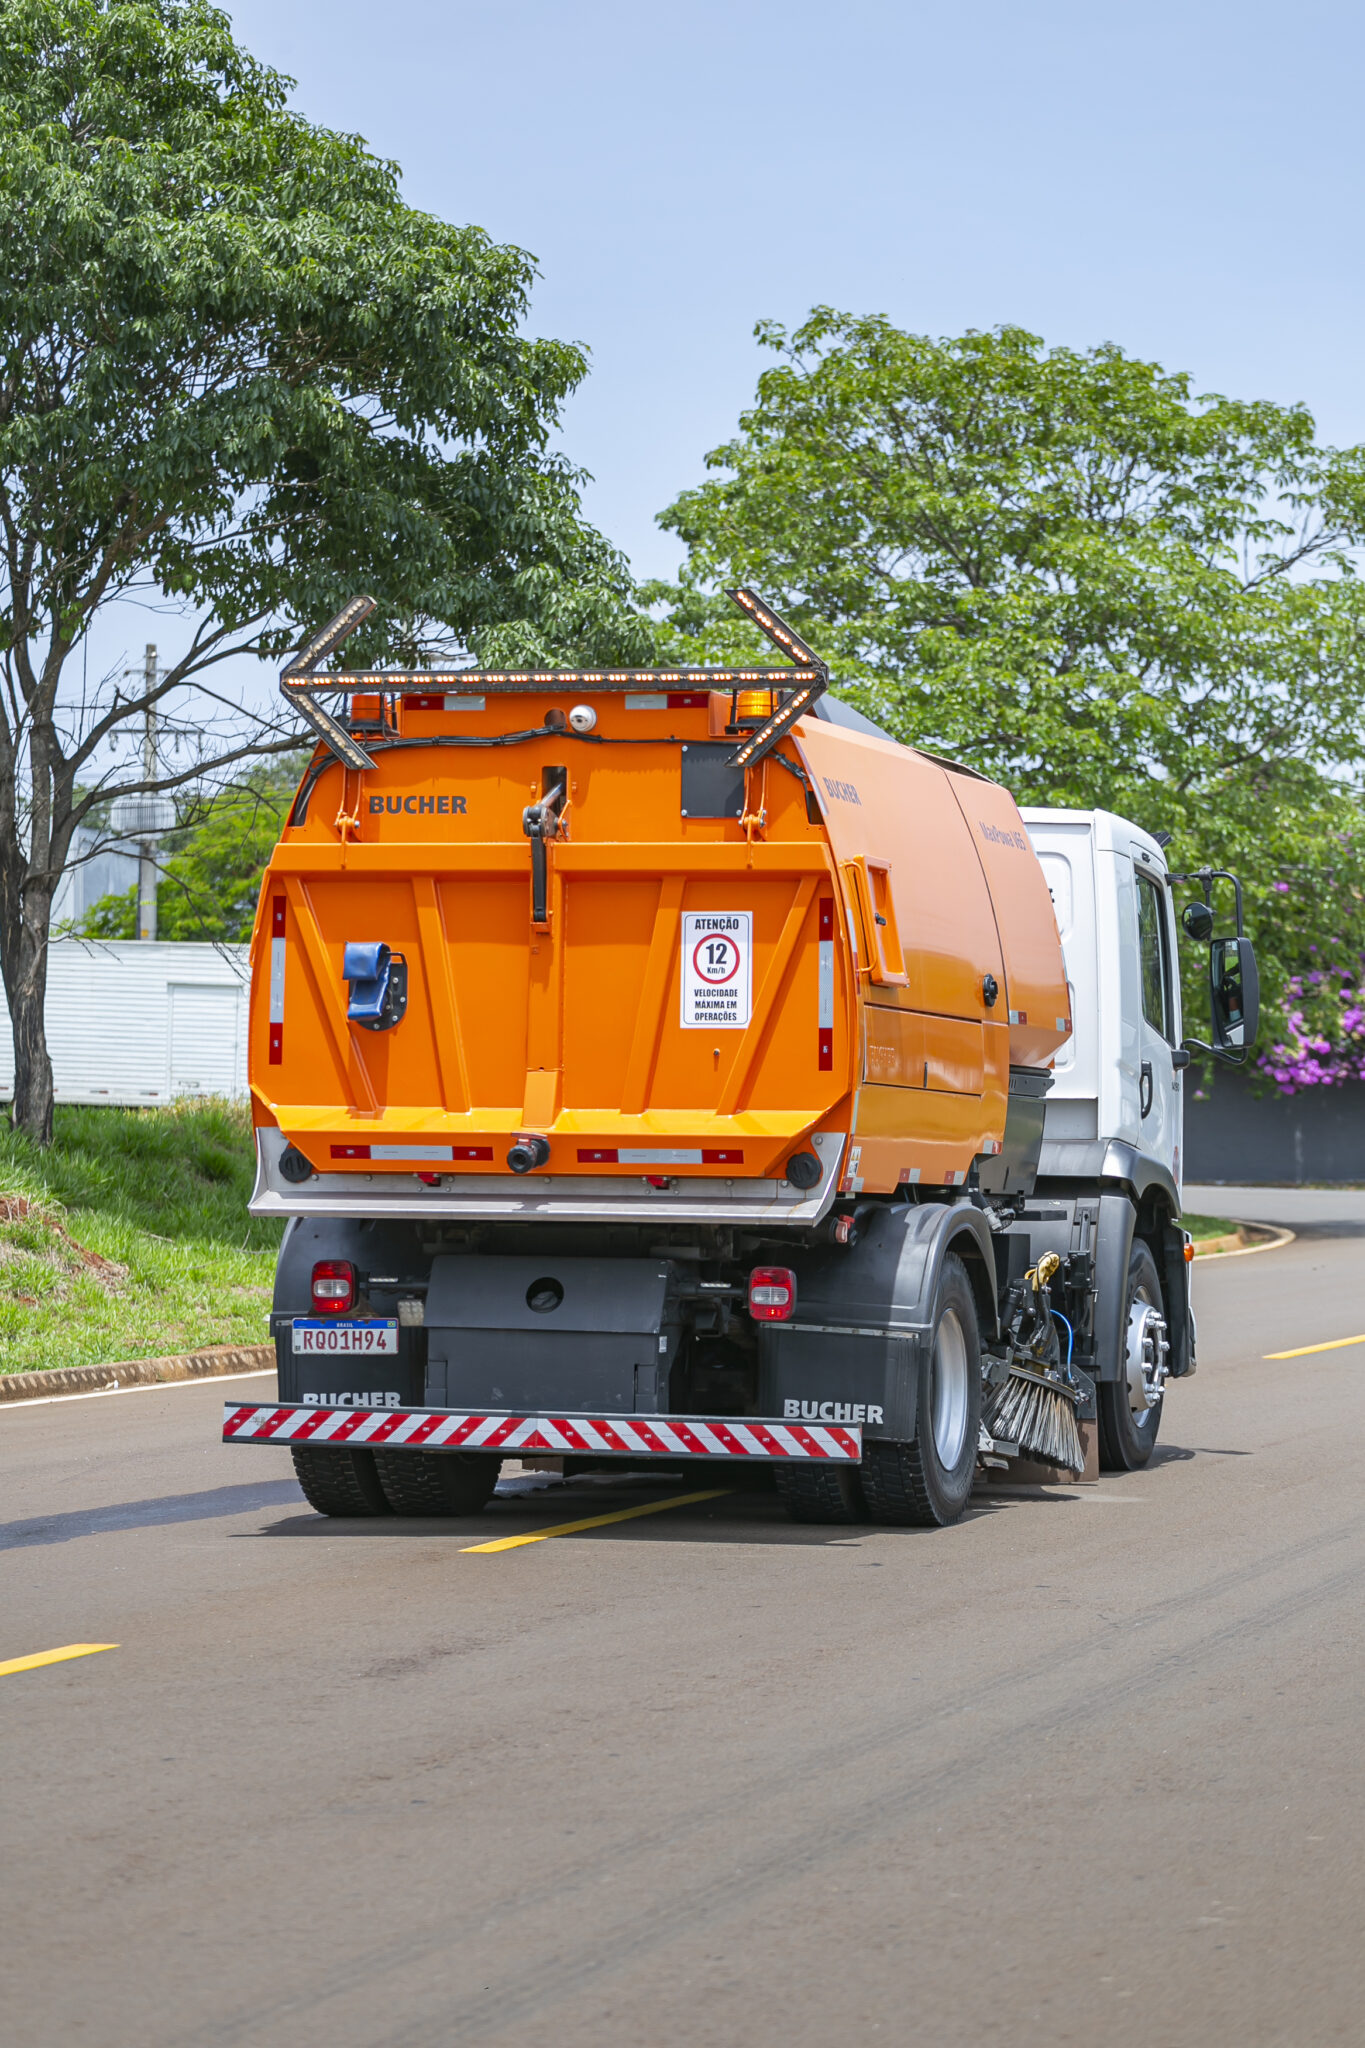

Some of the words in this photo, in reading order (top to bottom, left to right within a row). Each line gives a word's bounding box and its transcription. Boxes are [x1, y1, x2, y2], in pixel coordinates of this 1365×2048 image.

[822, 776, 862, 806] BUCHER
[369, 795, 468, 815] BUCHER
[694, 916, 739, 932] ATENÇÃO
[705, 943, 728, 965] 12
[706, 966, 726, 974] Km/h
[694, 988, 738, 998] VELOCIDADE
[694, 999, 725, 1009] MÁXIMA
[726, 1000, 737, 1009] EM
[694, 1010, 737, 1021] OPERAÇÕES
[303, 1392, 401, 1407] BUCHER
[783, 1398, 884, 1425] BUCHER
